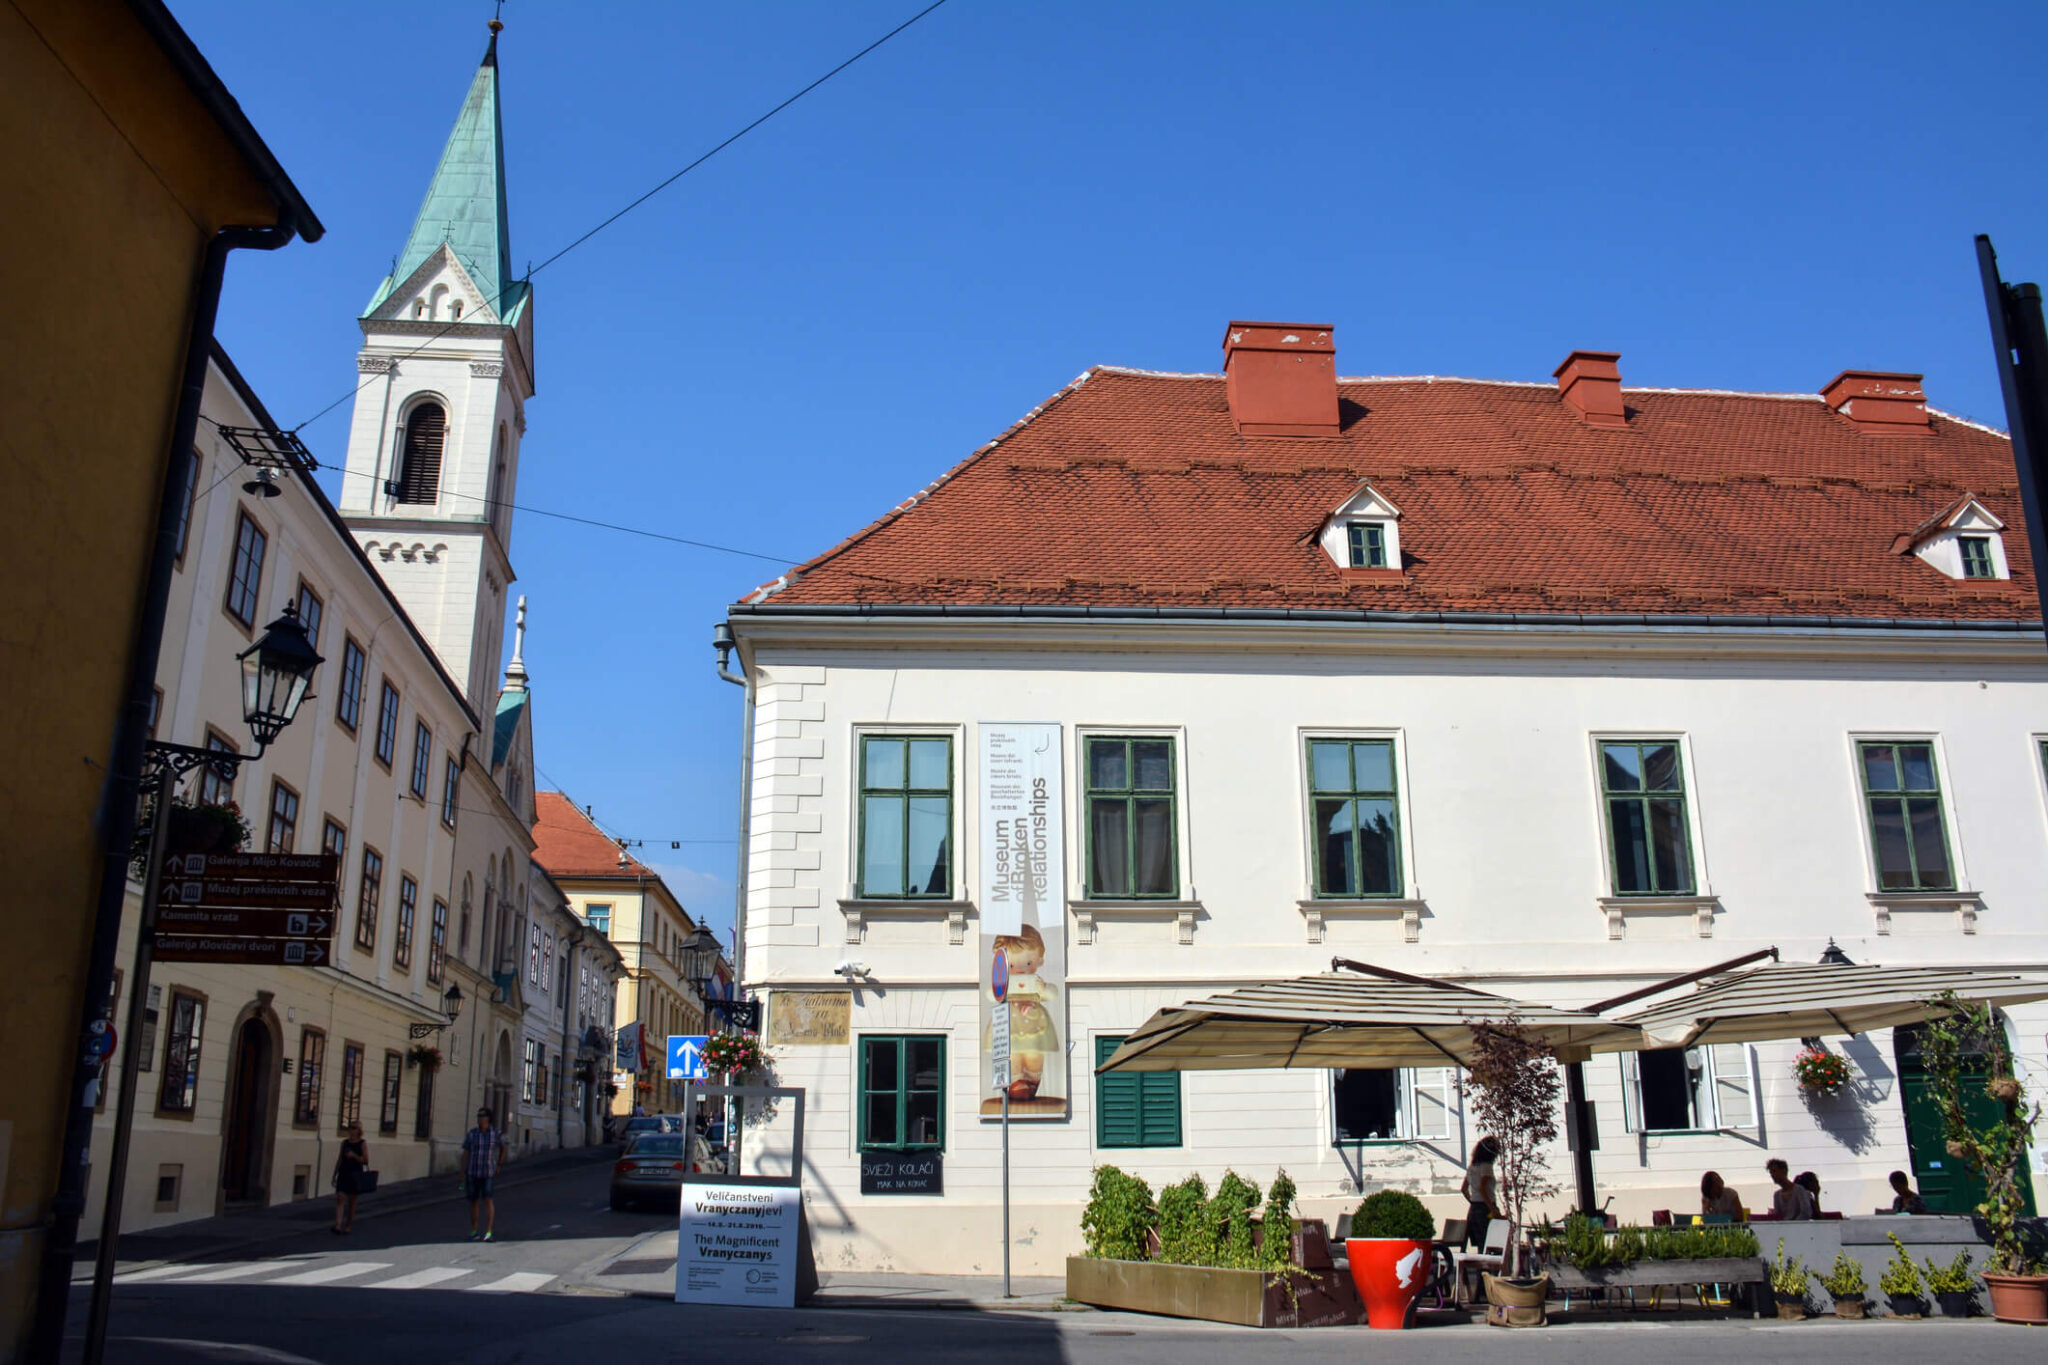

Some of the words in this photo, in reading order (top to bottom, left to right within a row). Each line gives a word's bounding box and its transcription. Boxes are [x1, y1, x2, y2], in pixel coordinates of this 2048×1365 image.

[1029, 777, 1049, 902] Relationships
[1011, 817, 1028, 884] Broken
[208, 855, 249, 867] Galerija
[252, 856, 276, 868] Mijo
[992, 820, 1010, 902] Museum
[207, 883, 240, 896] Muzej
[243, 885, 298, 897] prekinutih
[301, 888, 327, 897] veza
[160, 910, 209, 921] Kamenita
[212, 912, 239, 922] vrata
[156, 938, 197, 951] Galerija
[249, 941, 276, 951] dvori
[706, 1190, 774, 1203] Veličanstveni
[695, 1202, 782, 1218] Vranyczanyjevi
[694, 1233, 712, 1245] The
[716, 1234, 779, 1248] Magnificent
[699, 1246, 773, 1262] Vranyczanys
